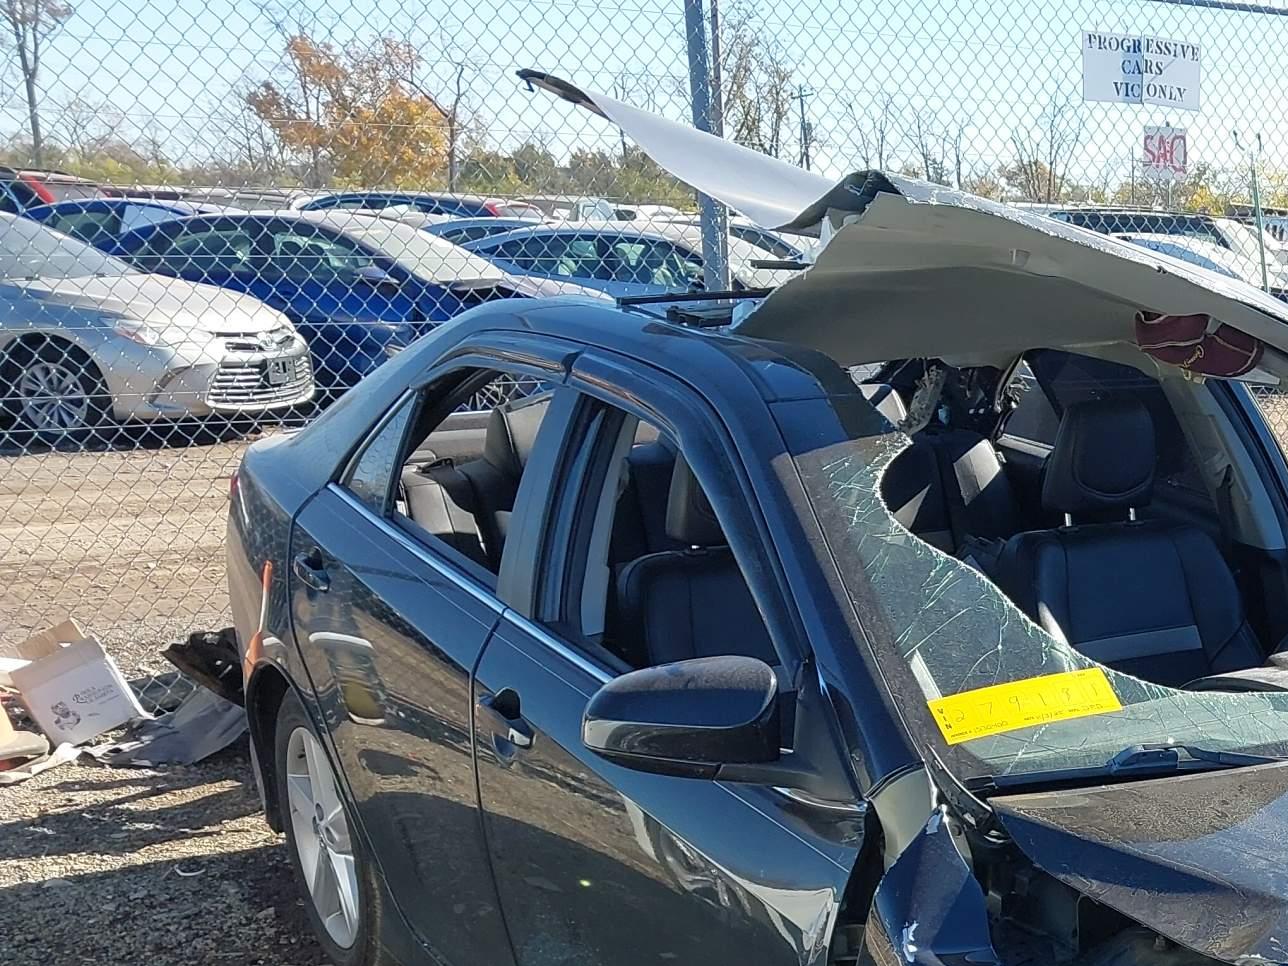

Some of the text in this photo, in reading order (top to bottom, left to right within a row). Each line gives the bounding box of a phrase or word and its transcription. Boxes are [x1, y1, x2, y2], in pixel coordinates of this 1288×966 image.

[1087, 33, 1200, 61] PROGRESSIVE
[1121, 58, 1163, 76] CARS
[1112, 81, 1187, 103] VIC ONLY
